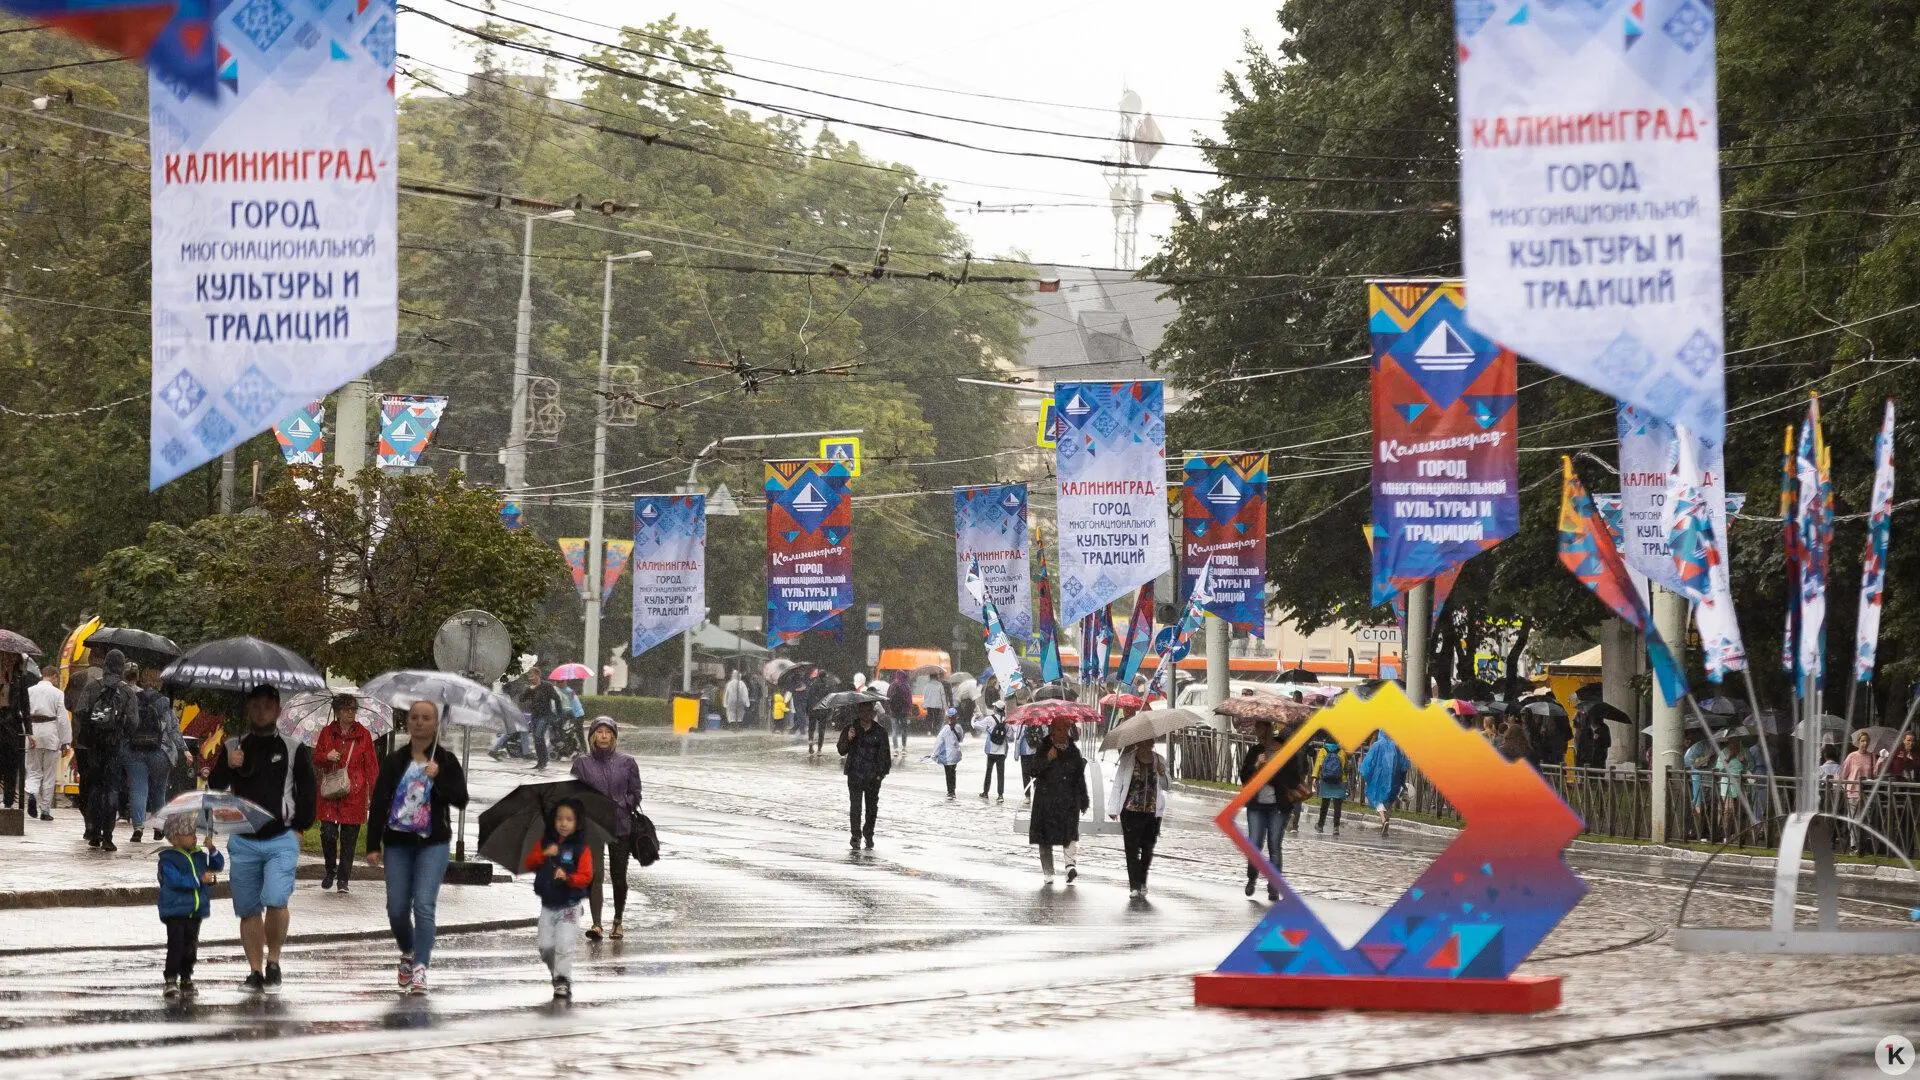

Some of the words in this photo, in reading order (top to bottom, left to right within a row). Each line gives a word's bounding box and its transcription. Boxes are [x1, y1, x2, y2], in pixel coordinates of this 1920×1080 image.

[1471, 108, 1709, 147] КАЛИНИНГРАД-
[165, 149, 387, 185] КАЛИНИНГРАД-
[1548, 161, 1640, 193] ГОРОД
[231, 200, 320, 230] ГОРОД
[1490, 196, 1700, 228] МНОГОНАЦИОНАЛЬНОЙ
[181, 234, 376, 263] МНОГОНАЦИОНАЛЬНОЙ
[1509, 235, 1656, 268] КУЛЬТУРЫ
[1667, 234, 1684, 261] И
[197, 272, 332, 302] КУЛЬТУРЫ
[343, 271, 359, 297] И
[1523, 269, 1675, 309] ТРАДИЦИЙ
[205, 306, 350, 342] ТРАДИЦИЙ
[1380, 431, 1507, 463] Калининград-
[1417, 460, 1468, 479] ГОРОД
[1061, 480, 1160, 496] КАЛИНИНГРАД-
[1381, 479, 1506, 496] МНОГОНАЦИОНАЛЬНОЙ
[1092, 502, 1131, 516] ГОРОД
[1395, 501, 1477, 518] КУЛЬТУРЫ
[1482, 501, 1492, 517] И
[1069, 518, 1156, 529] МНОГОНАЦИОНАЛЬНОЙ
[1405, 521, 1483, 543] ТРАДИЦИЙ
[1076, 533, 1138, 547] КУЛЬТУРЫ
[1141, 533, 1149, 546] И
[772, 546, 846, 566] Калининград-
[1081, 548, 1146, 565] ТРАДИЦИЙ
[1211, 555, 1239, 566] ГОРОД
[636, 561, 702, 571] КАЛИНИНГРАД-
[795, 563, 823, 574] ГОРОД
[656, 575, 682, 584] ГОРОД
[773, 575, 846, 585] МНОГОНАЦИОНАЛЬНОЙ
[1244, 579, 1251, 588] И
[781, 587, 829, 598] КУЛЬТУРЫ
[831, 587, 838, 597] И
[1012, 584, 1018, 593] И
[644, 596, 685, 604] КУЛЬТУРЫ
[686, 595, 692, 604] И
[787, 599, 833, 612] ТРАДИЦИЙ
[647, 605, 689, 616] ТРАДИЦИЙ
[1363, 629, 1396, 640] СТОП
